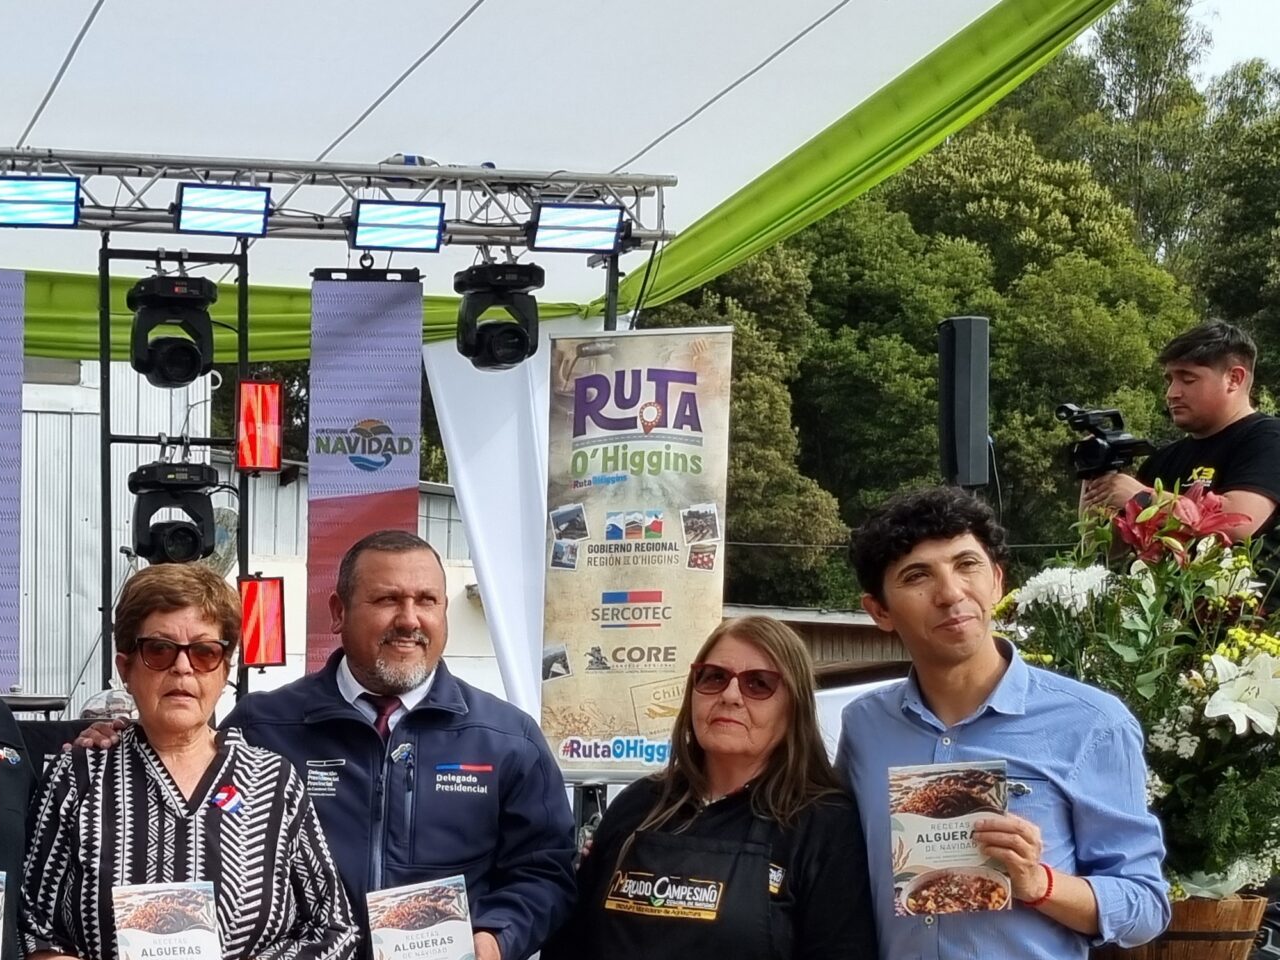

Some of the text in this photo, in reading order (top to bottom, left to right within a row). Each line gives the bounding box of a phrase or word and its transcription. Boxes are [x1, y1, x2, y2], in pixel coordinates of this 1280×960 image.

[573, 368, 703, 438] RUTA
[316, 436, 413, 455] NAVIDAD
[571, 444, 703, 478] O'Higgins
[587, 542, 680, 554] GOBIERNO REGIONAL
[587, 554, 621, 567] REGIÓN
[632, 554, 680, 565] O'HIGGINS
[591, 606, 672, 622] SERCOTEC
[611, 646, 677, 663] CORE
[652, 685, 683, 701] Chil
[562, 739, 671, 762] #RutaOHigg
[436, 773, 478, 784] Delegado
[435, 783, 488, 794] Presidencial
[931, 821, 970, 831] RECETAS
[925, 841, 978, 853] DE NAVIDAD
[614, 871, 718, 903] MERCADO CAMPESINO
[141, 946, 202, 957] ALGUERAS
[394, 935, 454, 953] ALGUERAS
